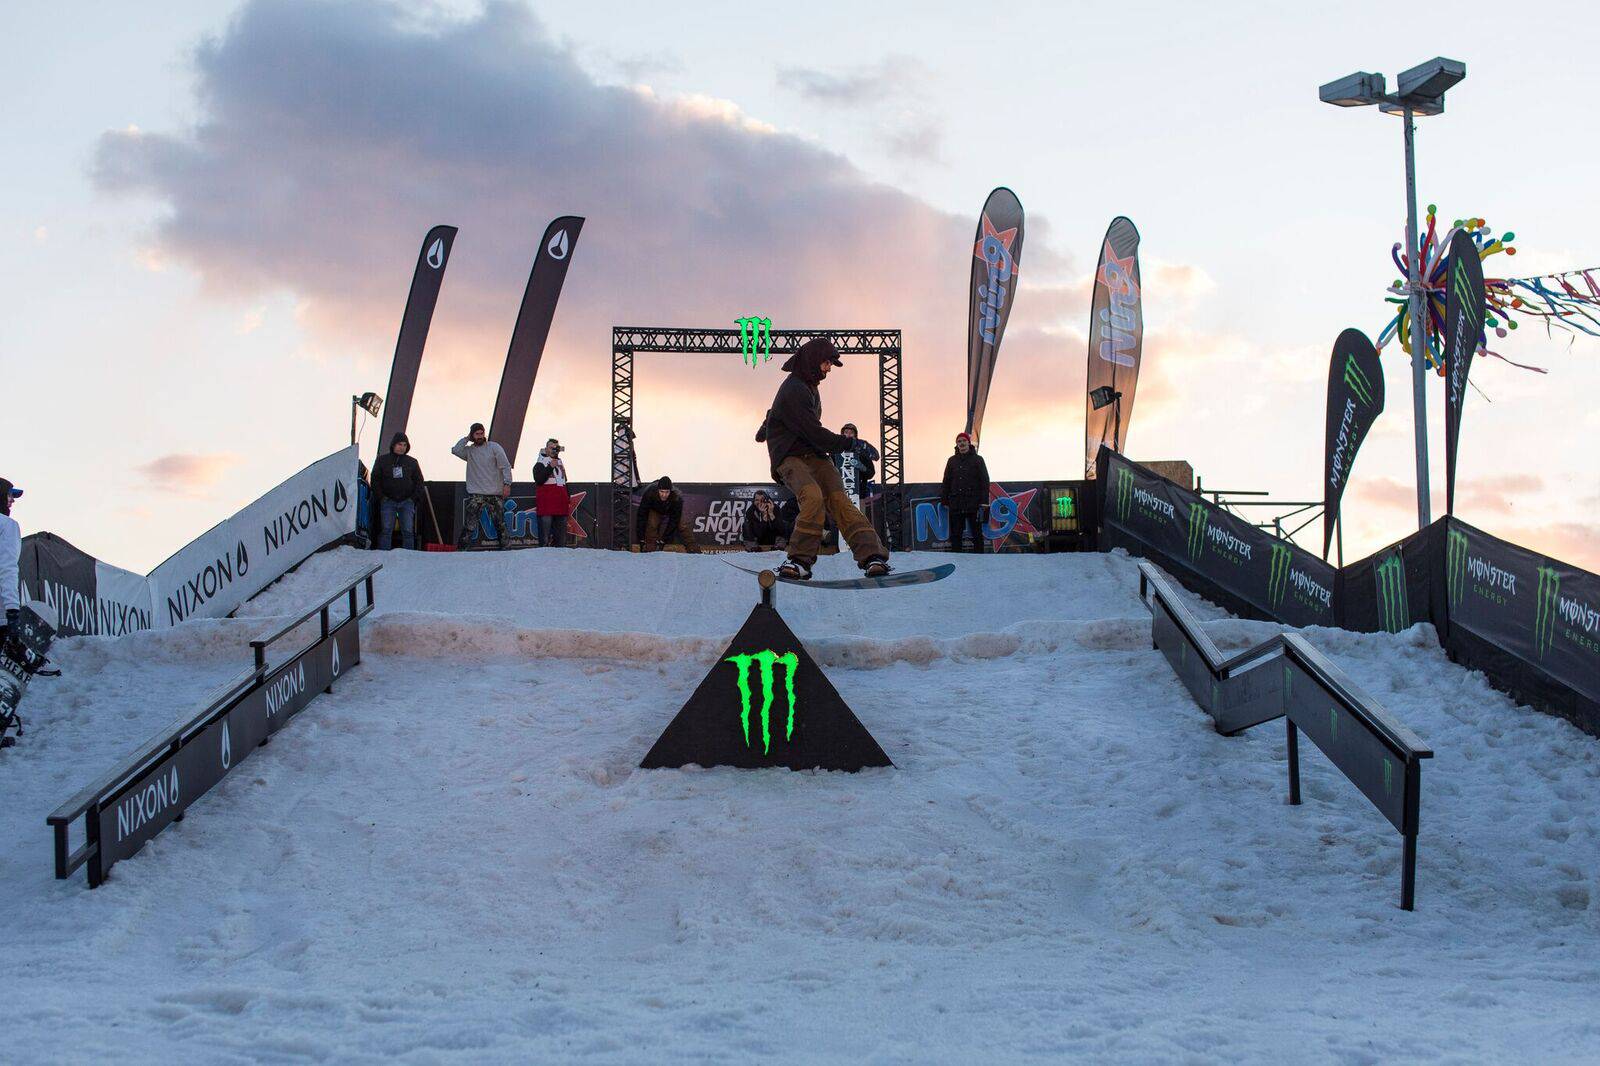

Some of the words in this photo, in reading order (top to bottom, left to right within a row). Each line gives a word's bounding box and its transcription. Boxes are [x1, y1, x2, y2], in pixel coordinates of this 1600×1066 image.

[264, 489, 328, 556] NIXON
[1133, 488, 1175, 519] MONSTER
[1207, 525, 1252, 560] MONSTER
[168, 552, 233, 626] NIXON
[1290, 567, 1332, 608] MONSTER
[1467, 556, 1516, 595] MONSTER
[1473, 584, 1508, 606] ENERGY
[44, 579, 95, 635] NIXON
[100, 598, 151, 637] NIXON
[265, 672, 298, 718] NIXON
[117, 779, 169, 842] NIXON
